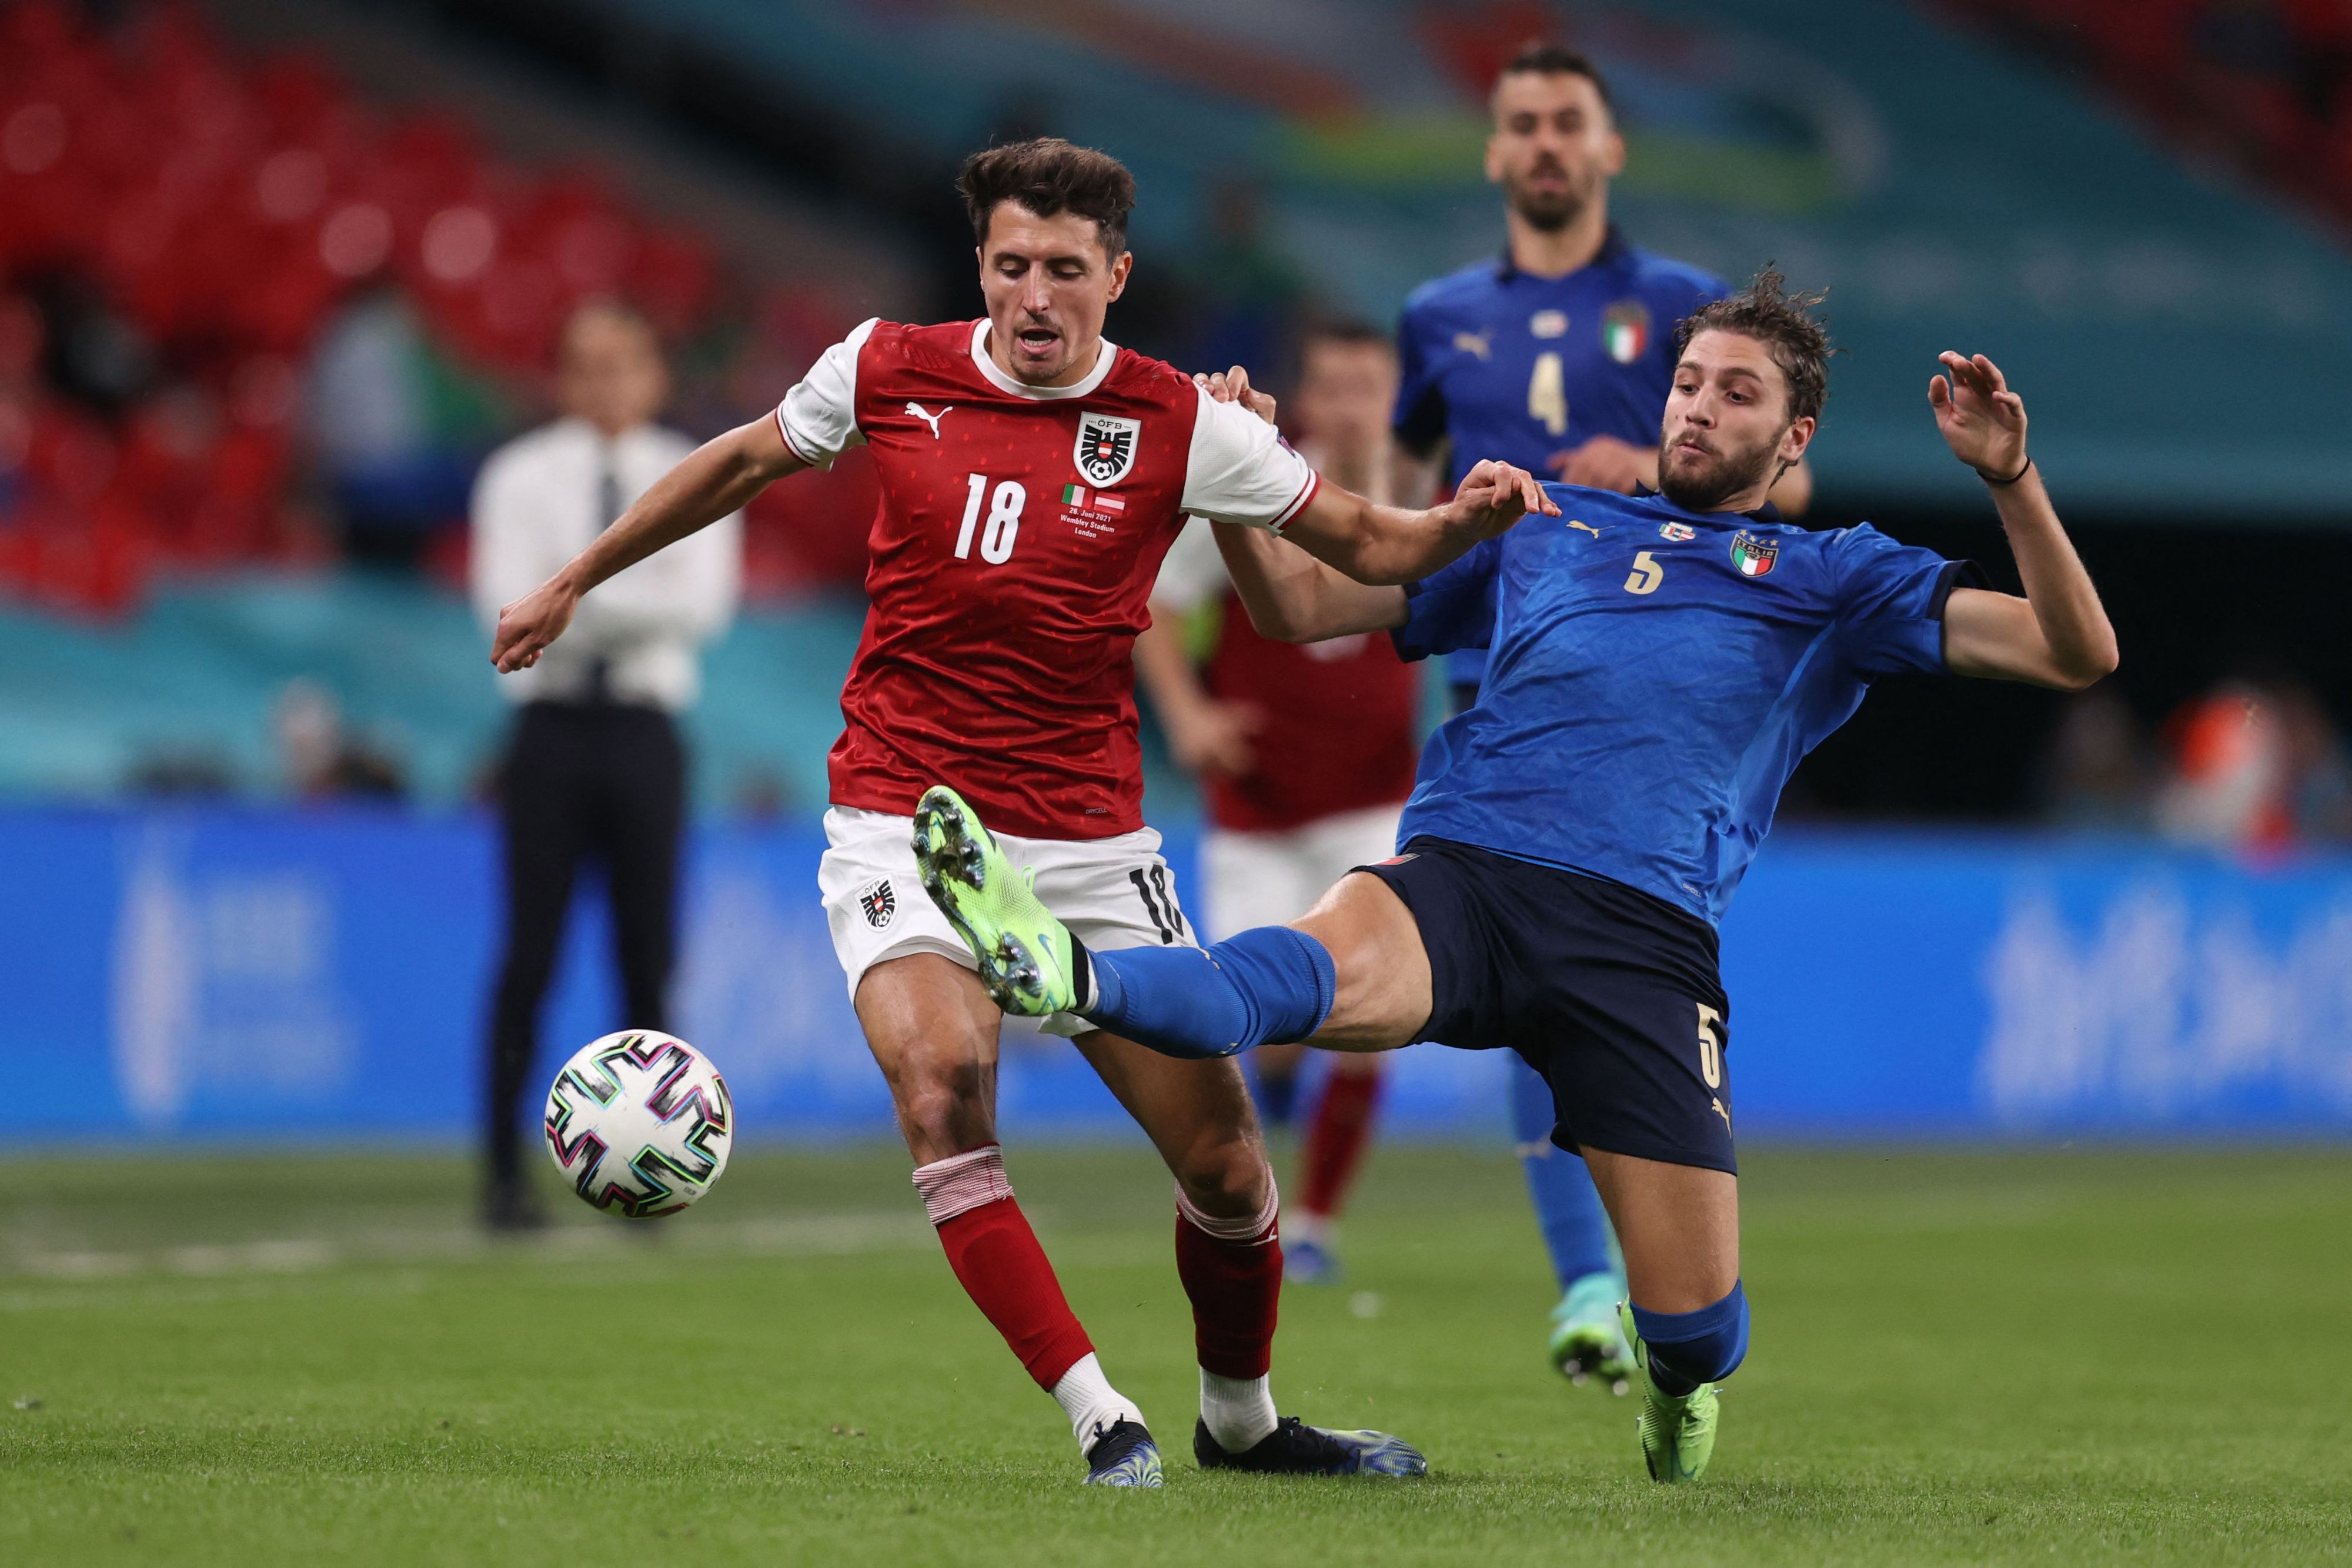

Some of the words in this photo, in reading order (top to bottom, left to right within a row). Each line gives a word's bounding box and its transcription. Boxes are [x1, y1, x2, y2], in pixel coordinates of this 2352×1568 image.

[1529, 352, 1567, 436] 4
[1098, 419, 1122, 429] ÖFB
[954, 472, 1027, 565] 18
[1060, 514, 1088, 528] Wembley
[1090, 521, 1115, 533] Stadium
[1069, 507, 1079, 515] 26.
[1081, 510, 1095, 519] Juni
[1095, 513, 1111, 523] 2021
[1074, 527, 1097, 539] London
[1737, 539, 1774, 556] ITALIA
[1623, 551, 1671, 595] 5
[1129, 864, 1184, 945] 18
[1696, 1002, 1720, 1089] 5
